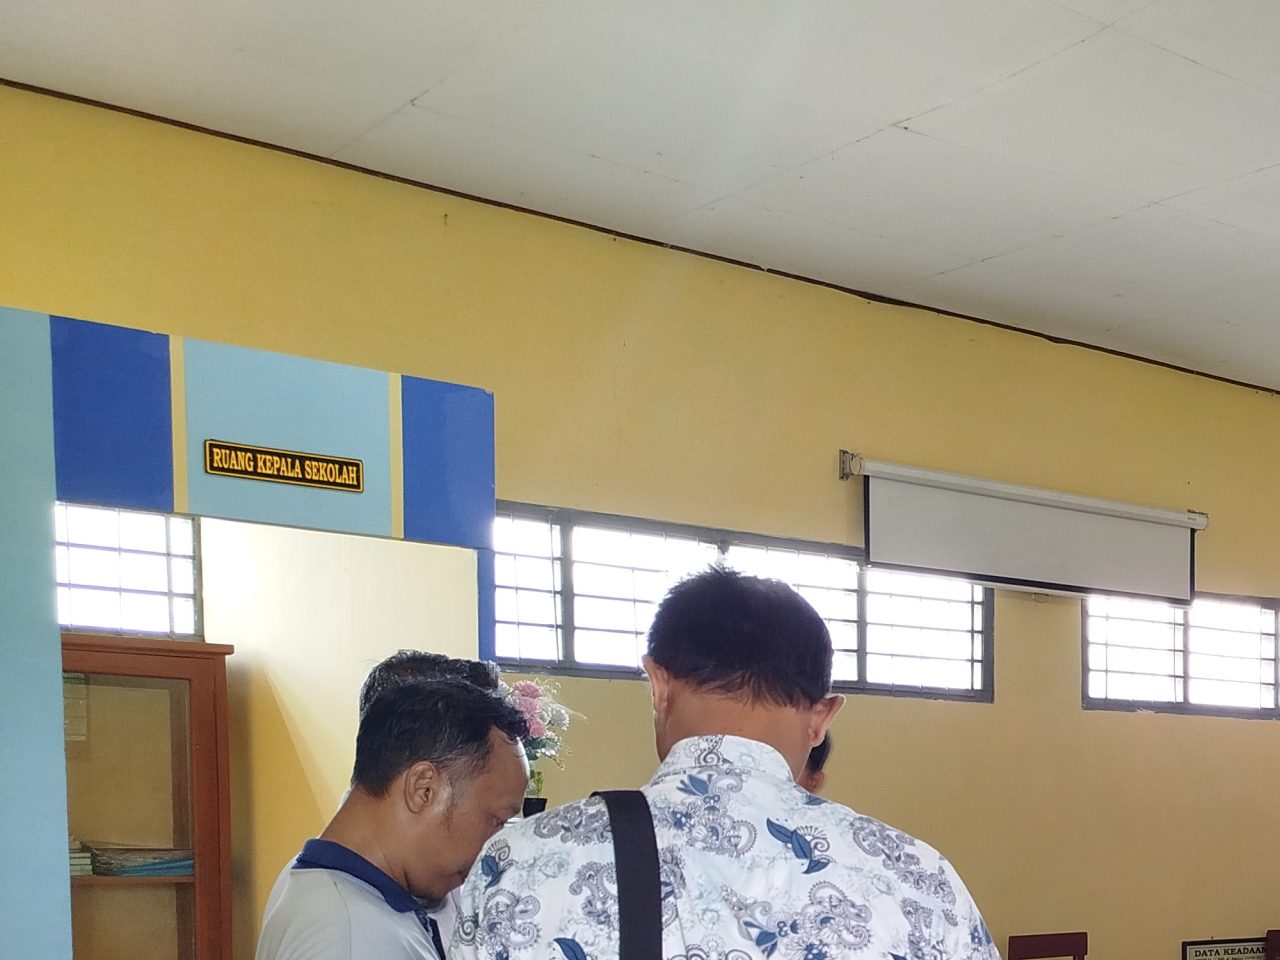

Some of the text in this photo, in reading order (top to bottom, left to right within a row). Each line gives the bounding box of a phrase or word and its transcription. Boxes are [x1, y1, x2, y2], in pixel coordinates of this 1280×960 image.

[213, 448, 357, 485] RUANG KEPALA SEKOLAH
[1194, 949, 1220, 957] DATA
